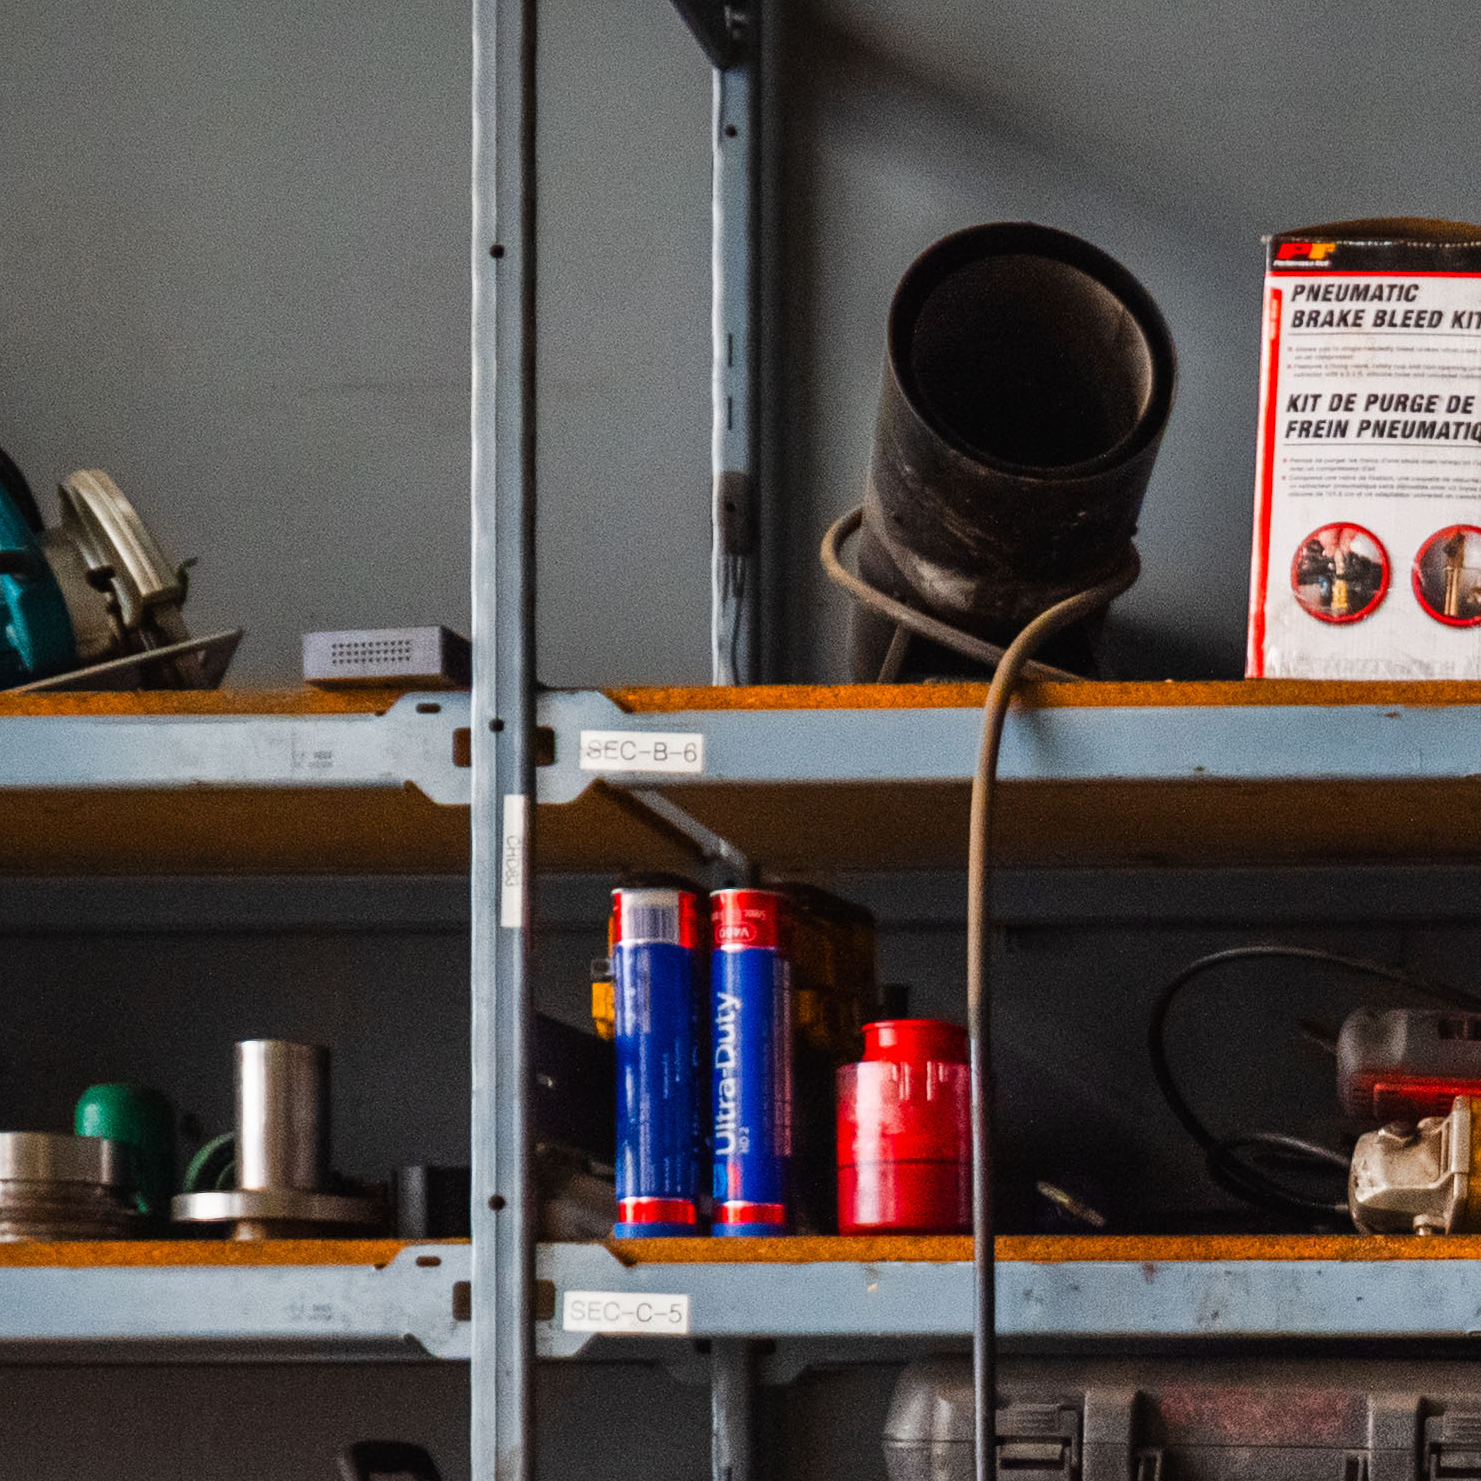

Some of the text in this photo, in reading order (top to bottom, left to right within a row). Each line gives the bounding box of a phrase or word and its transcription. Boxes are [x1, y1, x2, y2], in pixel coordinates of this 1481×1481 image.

[1291, 284, 1419, 302] PNEUMATIC
[1291, 309, 1366, 328] BRAKE
[1373, 309, 1443, 329] BLEED
[1286, 393, 1475, 414] KIT DE PURGE DE
[1285, 420, 1349, 439] FREIN
[585, 740, 698, 762] SEC-B-6
[714, 991, 743, 1155] Ultra-Duty
[570, 1300, 682, 1323] SEC-C-5
